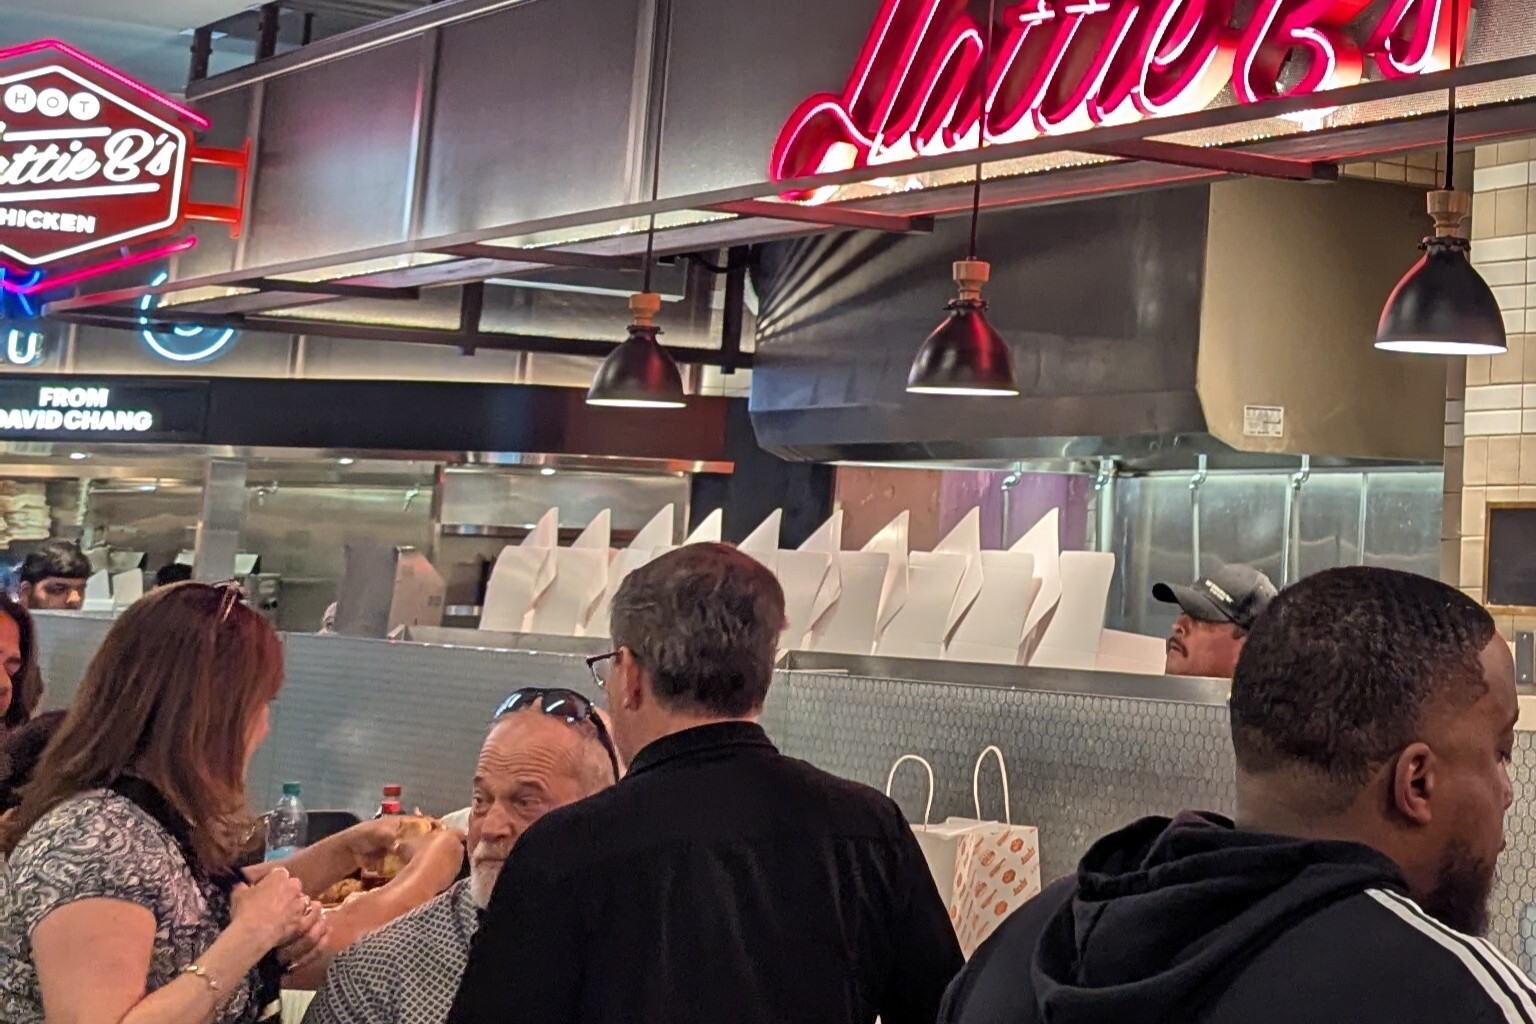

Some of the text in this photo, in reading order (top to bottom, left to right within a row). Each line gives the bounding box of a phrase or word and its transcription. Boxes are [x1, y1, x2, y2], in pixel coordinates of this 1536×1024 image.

[9, 88, 95, 116] HOT
[0, 128, 177, 185] ttie B's
[0, 207, 96, 234] HICKEN
[38, 386, 110, 408] FROM
[64, 409, 153, 431] CHANG
